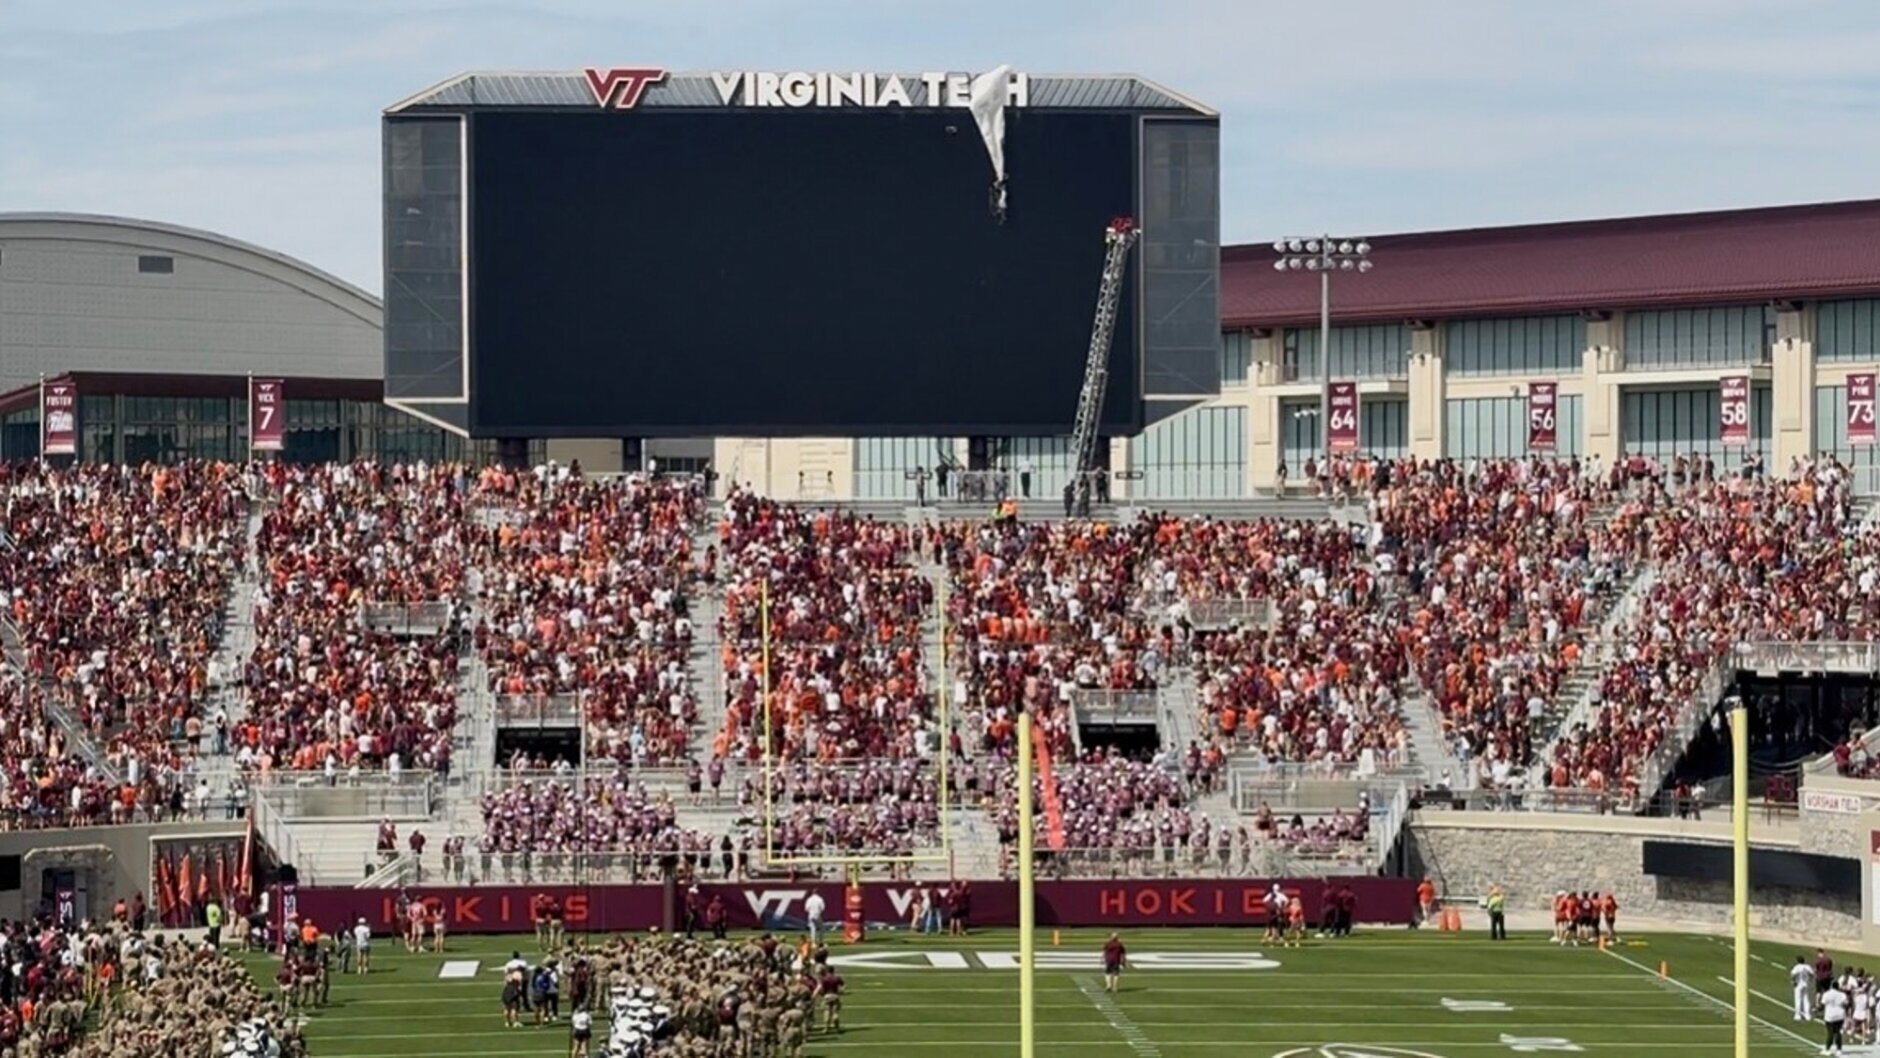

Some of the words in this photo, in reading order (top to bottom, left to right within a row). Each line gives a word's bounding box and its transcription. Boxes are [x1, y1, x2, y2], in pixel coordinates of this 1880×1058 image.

[584, 68, 664, 109] VT
[712, 71, 912, 107] VIRGINIA
[922, 71, 1028, 107] TEH
[260, 407, 274, 430] 7
[1330, 409, 1355, 430] 64
[1531, 408, 1554, 430] 56
[1721, 401, 1747, 425] 58
[1848, 400, 1874, 424] 73
[744, 889, 807, 919] VT
